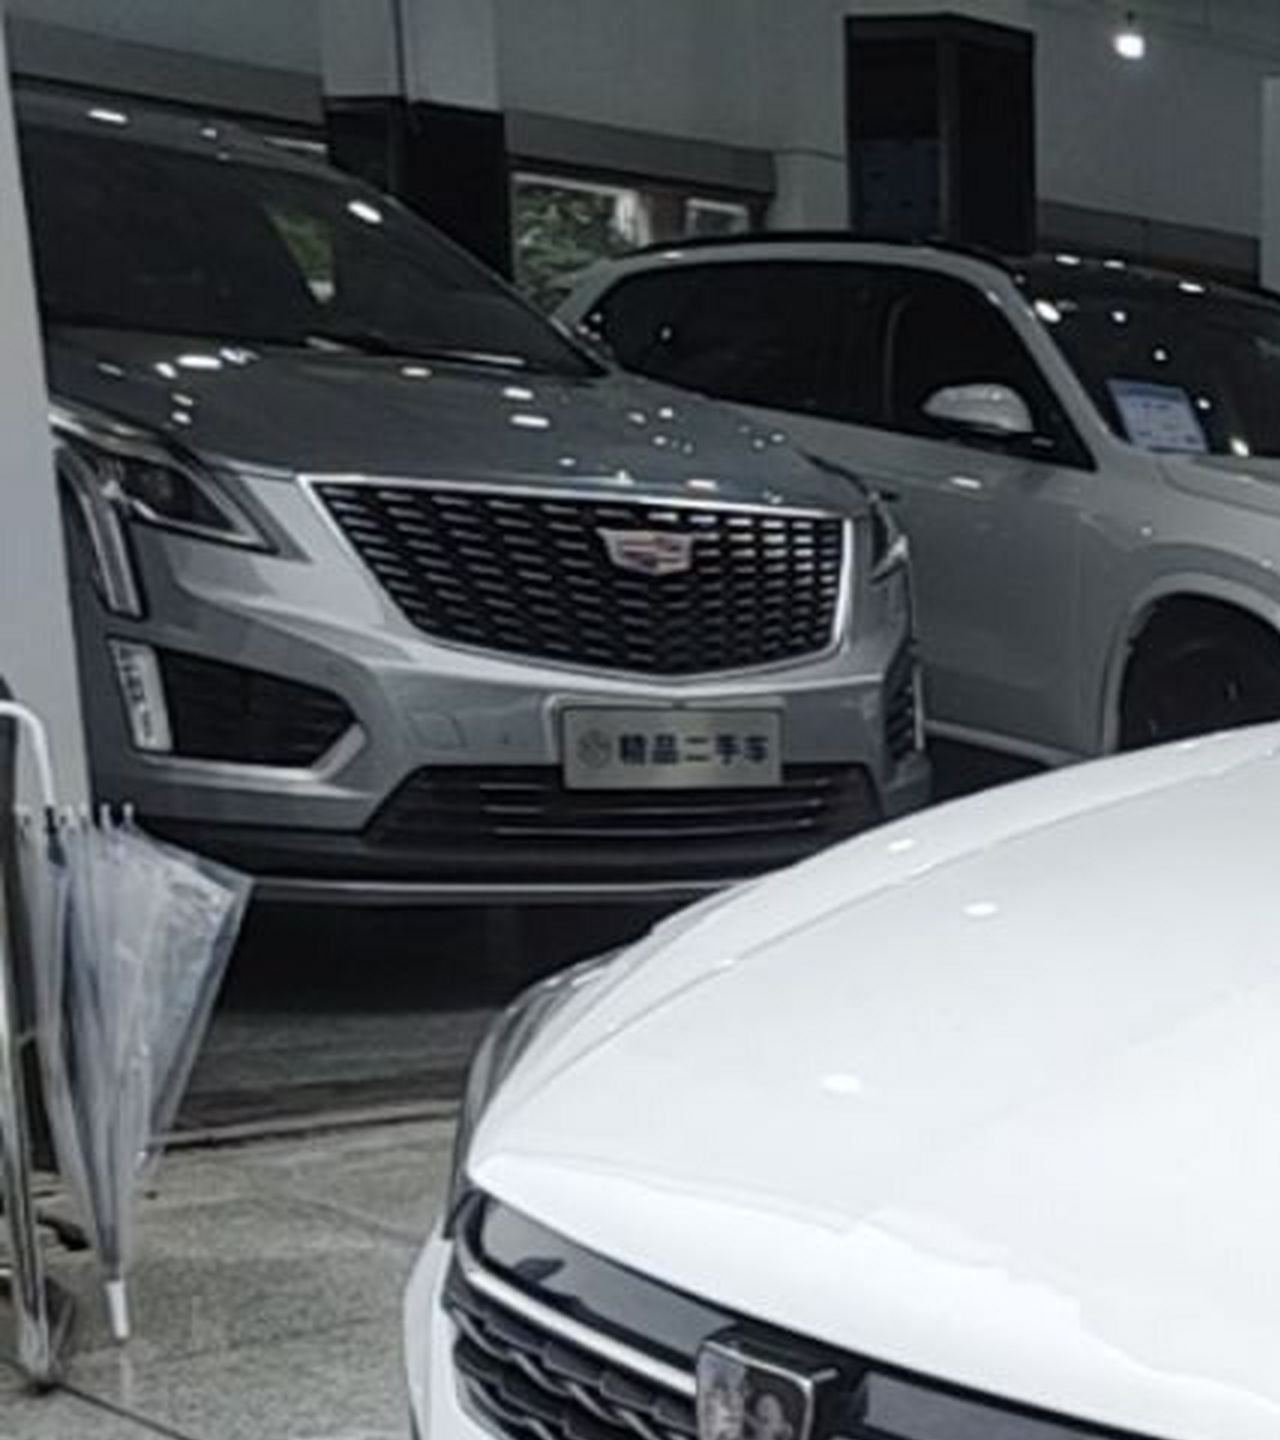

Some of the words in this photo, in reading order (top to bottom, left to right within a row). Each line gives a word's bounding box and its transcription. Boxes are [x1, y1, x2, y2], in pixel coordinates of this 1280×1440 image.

[619, 732, 770, 767] 精品二手车
